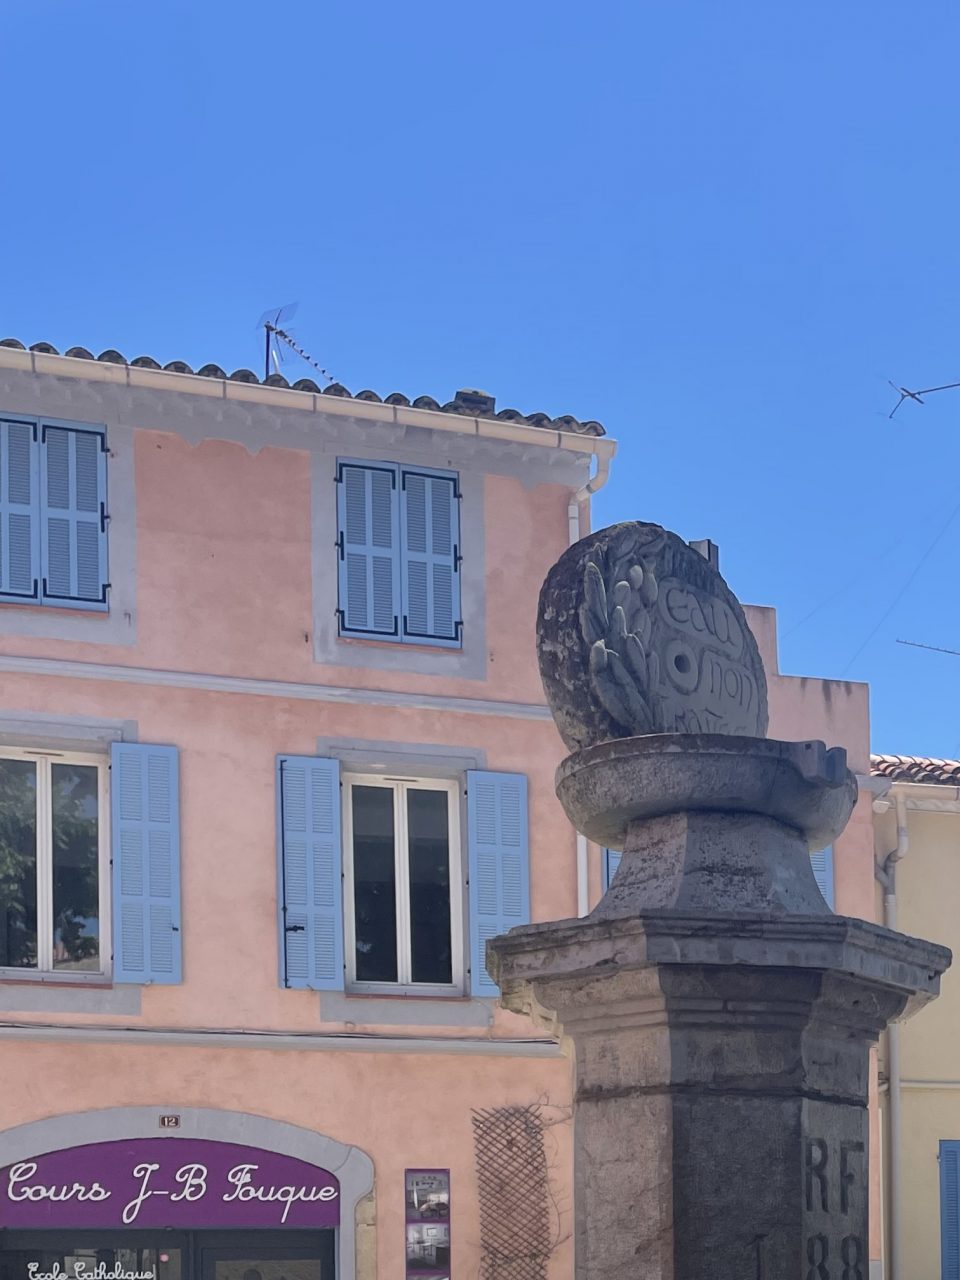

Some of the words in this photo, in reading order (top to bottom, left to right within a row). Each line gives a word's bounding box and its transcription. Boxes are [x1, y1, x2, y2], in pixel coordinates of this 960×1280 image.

[164, 1117, 176, 1126] 12
[8, 1162, 111, 1201] Cours
[122, 1163, 208, 1224] J-B
[223, 1164, 338, 1224] Fouque
[27, 1262, 68, 1280] Ecole
